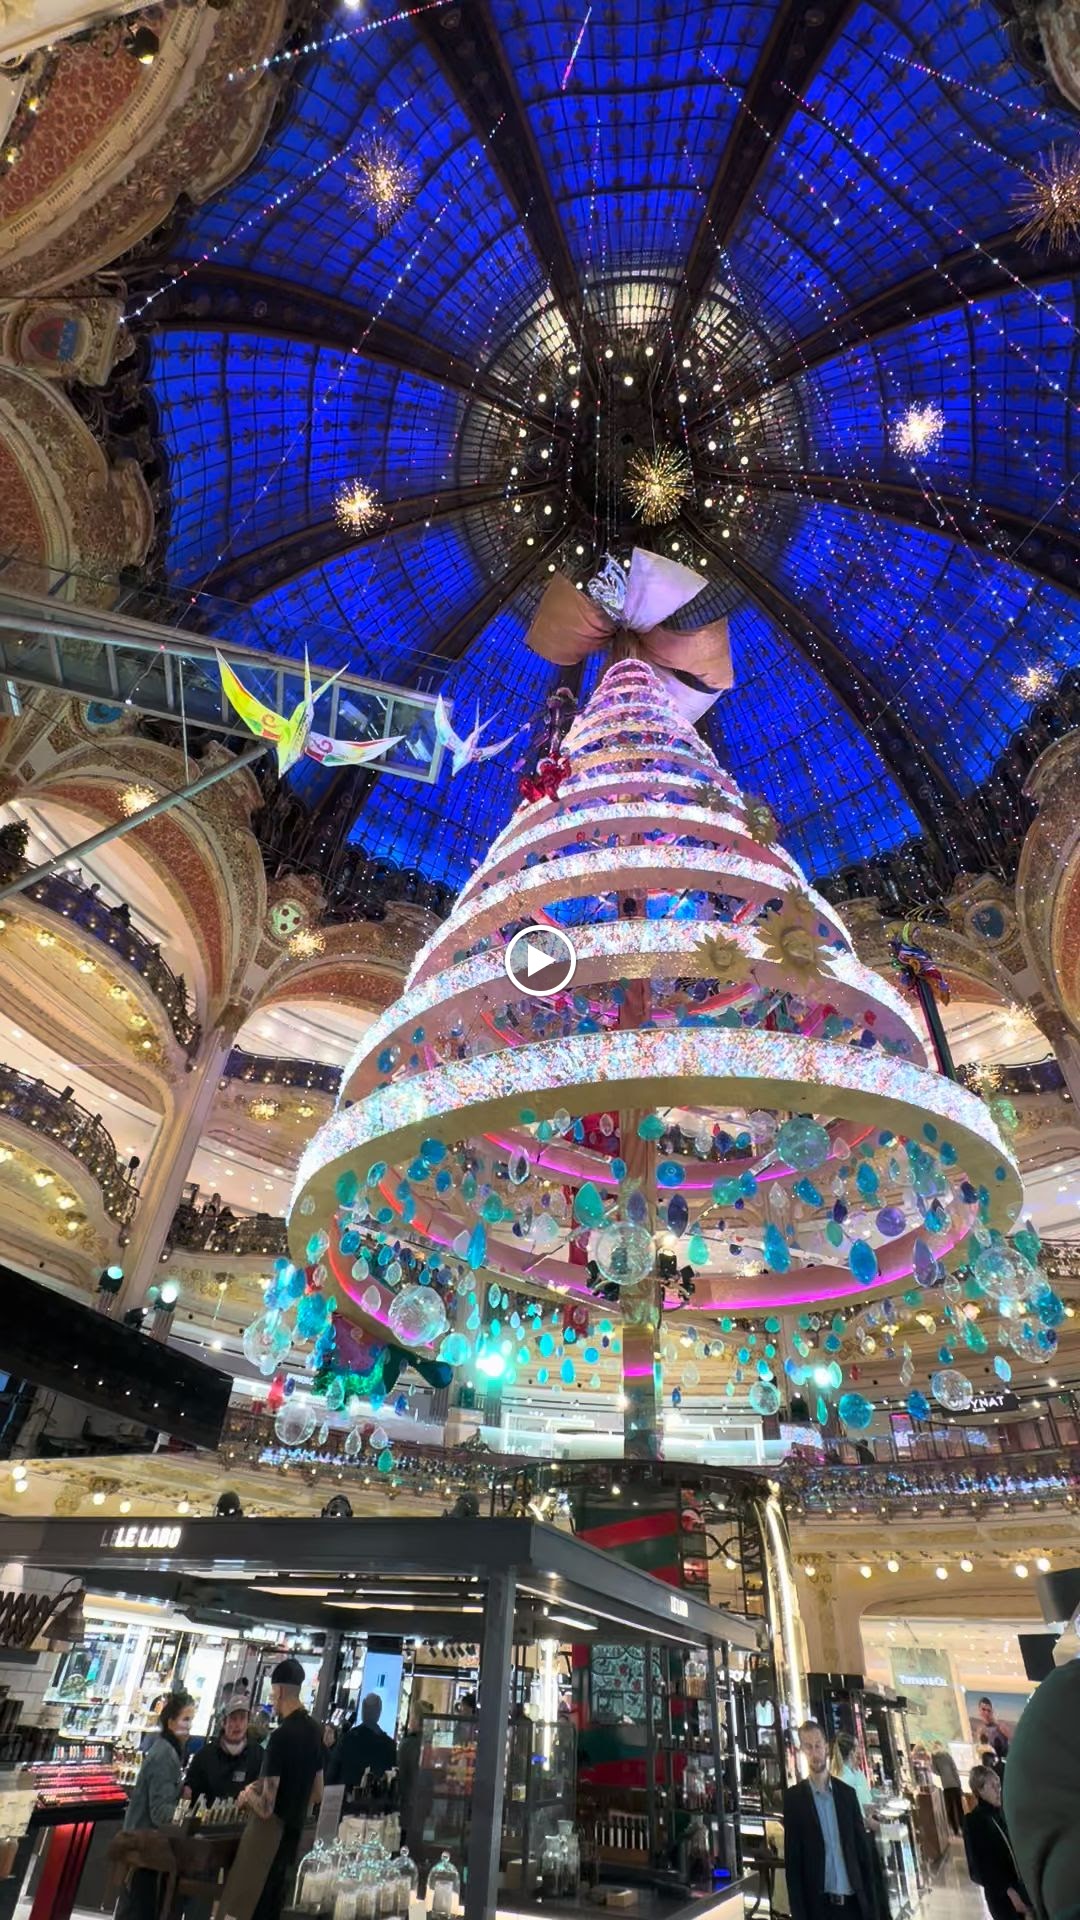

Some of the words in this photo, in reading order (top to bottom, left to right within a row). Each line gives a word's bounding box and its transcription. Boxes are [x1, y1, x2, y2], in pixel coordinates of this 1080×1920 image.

[950, 1396, 1004, 1409] YNAT
[114, 1527, 138, 1548] LE
[138, 1527, 181, 1548] LABO
